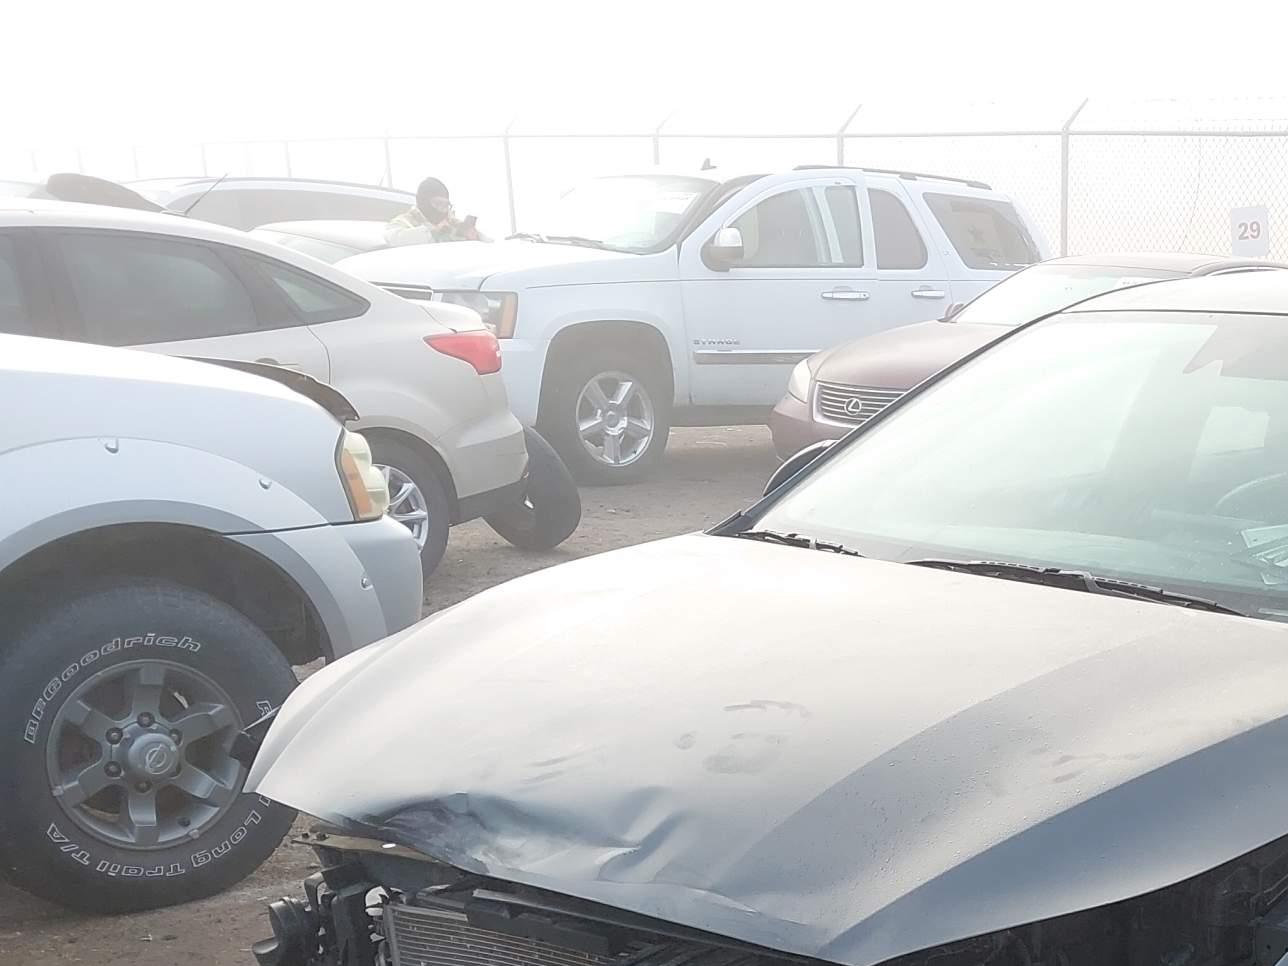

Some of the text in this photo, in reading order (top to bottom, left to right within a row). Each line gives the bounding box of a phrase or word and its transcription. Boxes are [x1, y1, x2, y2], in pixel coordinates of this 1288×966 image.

[1238, 221, 1261, 241] 29
[24, 633, 201, 745] BFGoodrich
[46, 810, 263, 877] Long Trail T/A
